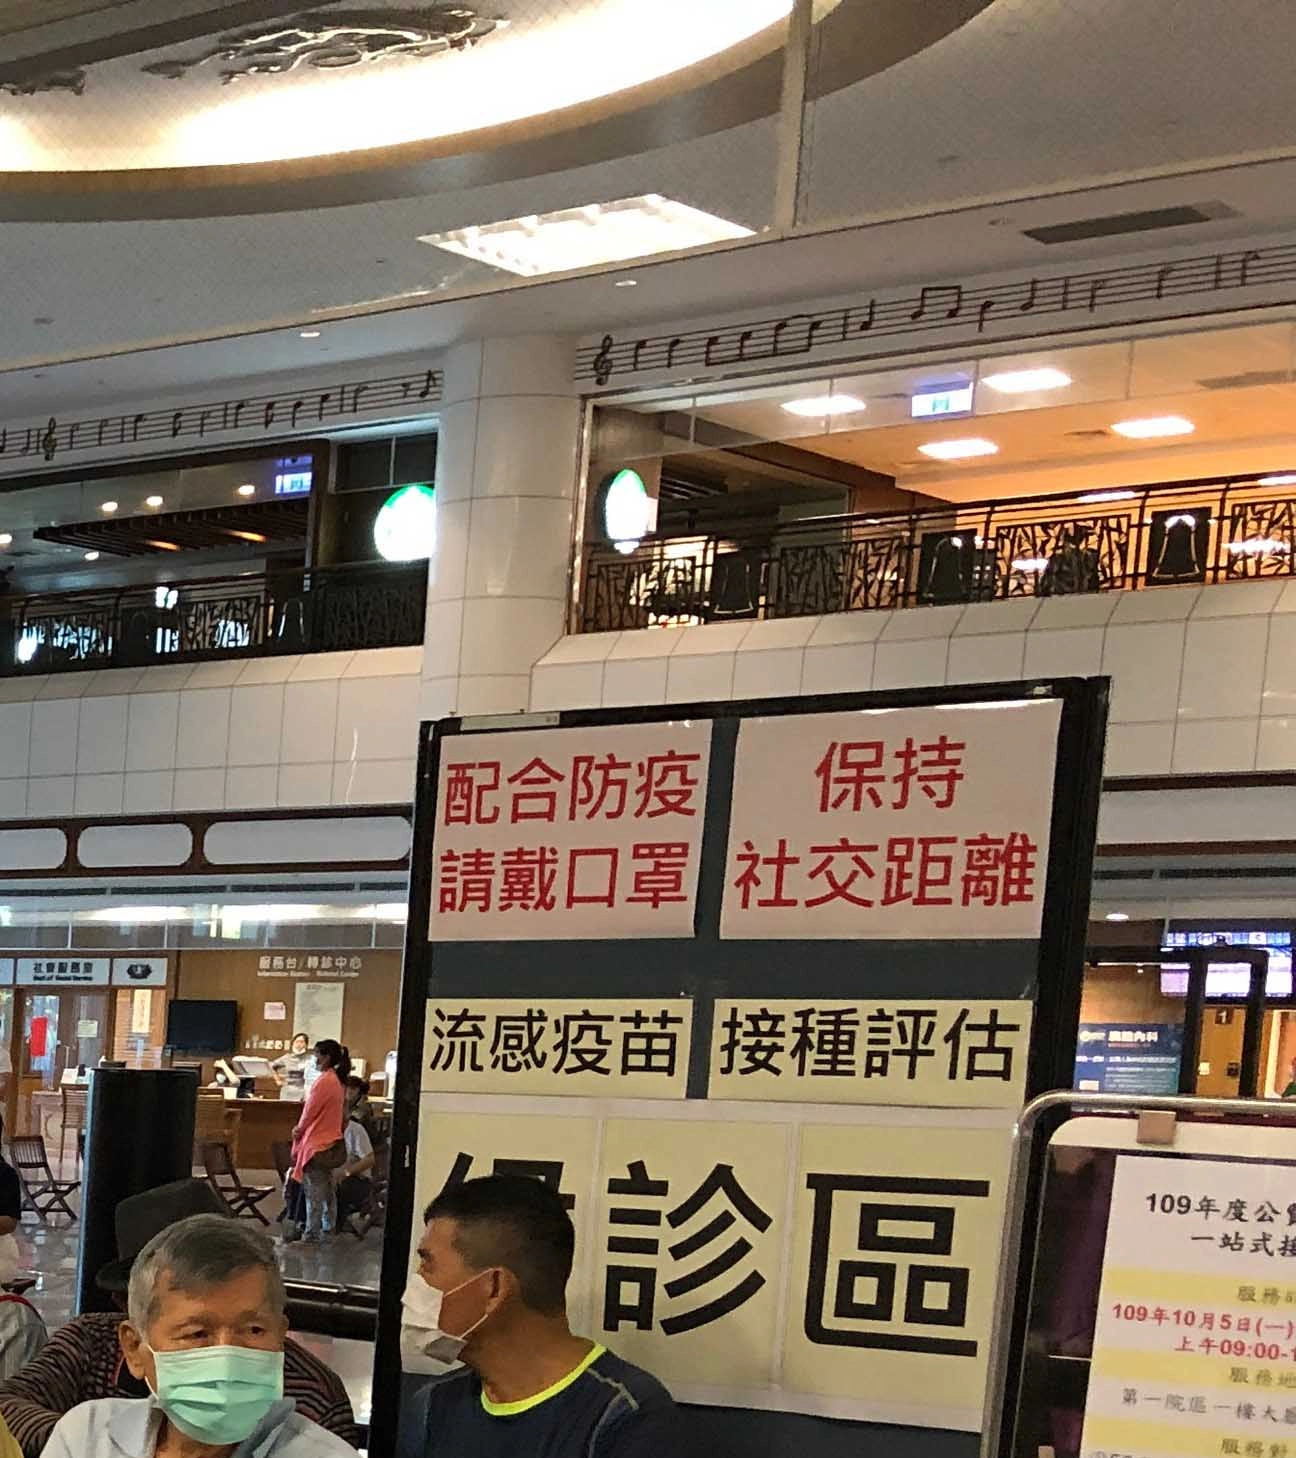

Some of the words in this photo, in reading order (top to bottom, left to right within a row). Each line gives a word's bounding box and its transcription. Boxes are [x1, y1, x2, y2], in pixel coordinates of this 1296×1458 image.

[444, 750, 701, 826] 配合防疫
[814, 735, 966, 813] 保持
[439, 842, 690, 914] 請戴口罩
[734, 832, 1038, 910] 社交距離
[429, 1008, 685, 1078] 流感疫苗
[719, 1007, 1022, 1082] 接種評估
[442, 1151, 991, 1358] 診區
